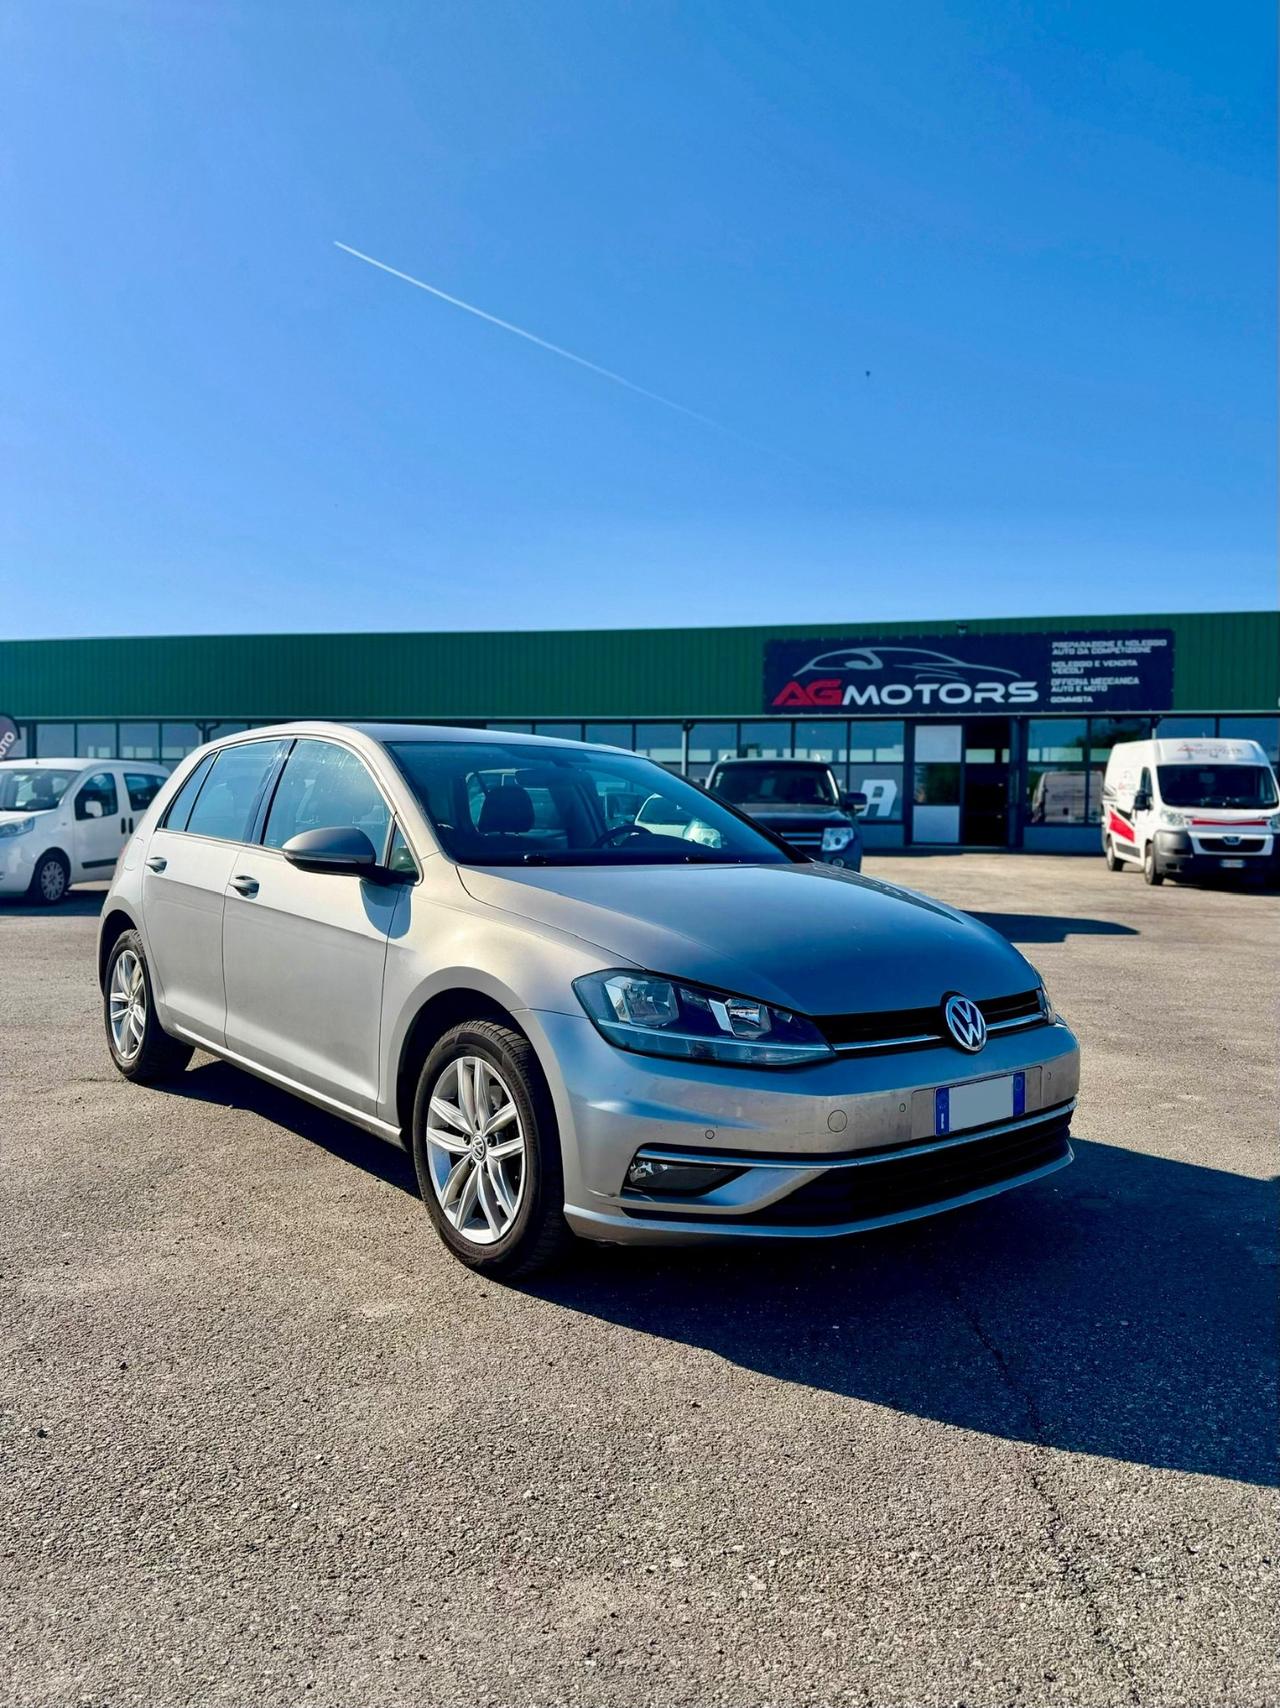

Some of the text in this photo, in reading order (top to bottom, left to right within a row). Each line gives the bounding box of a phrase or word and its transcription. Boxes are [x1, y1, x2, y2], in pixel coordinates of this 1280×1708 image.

[1051, 660, 1093, 668] NOLEGGIO
[1102, 659, 1138, 667] VENDITA
[1051, 677, 1140, 686] OFFICINA MECCANICA
[1083, 684, 1108, 692] MOTO
